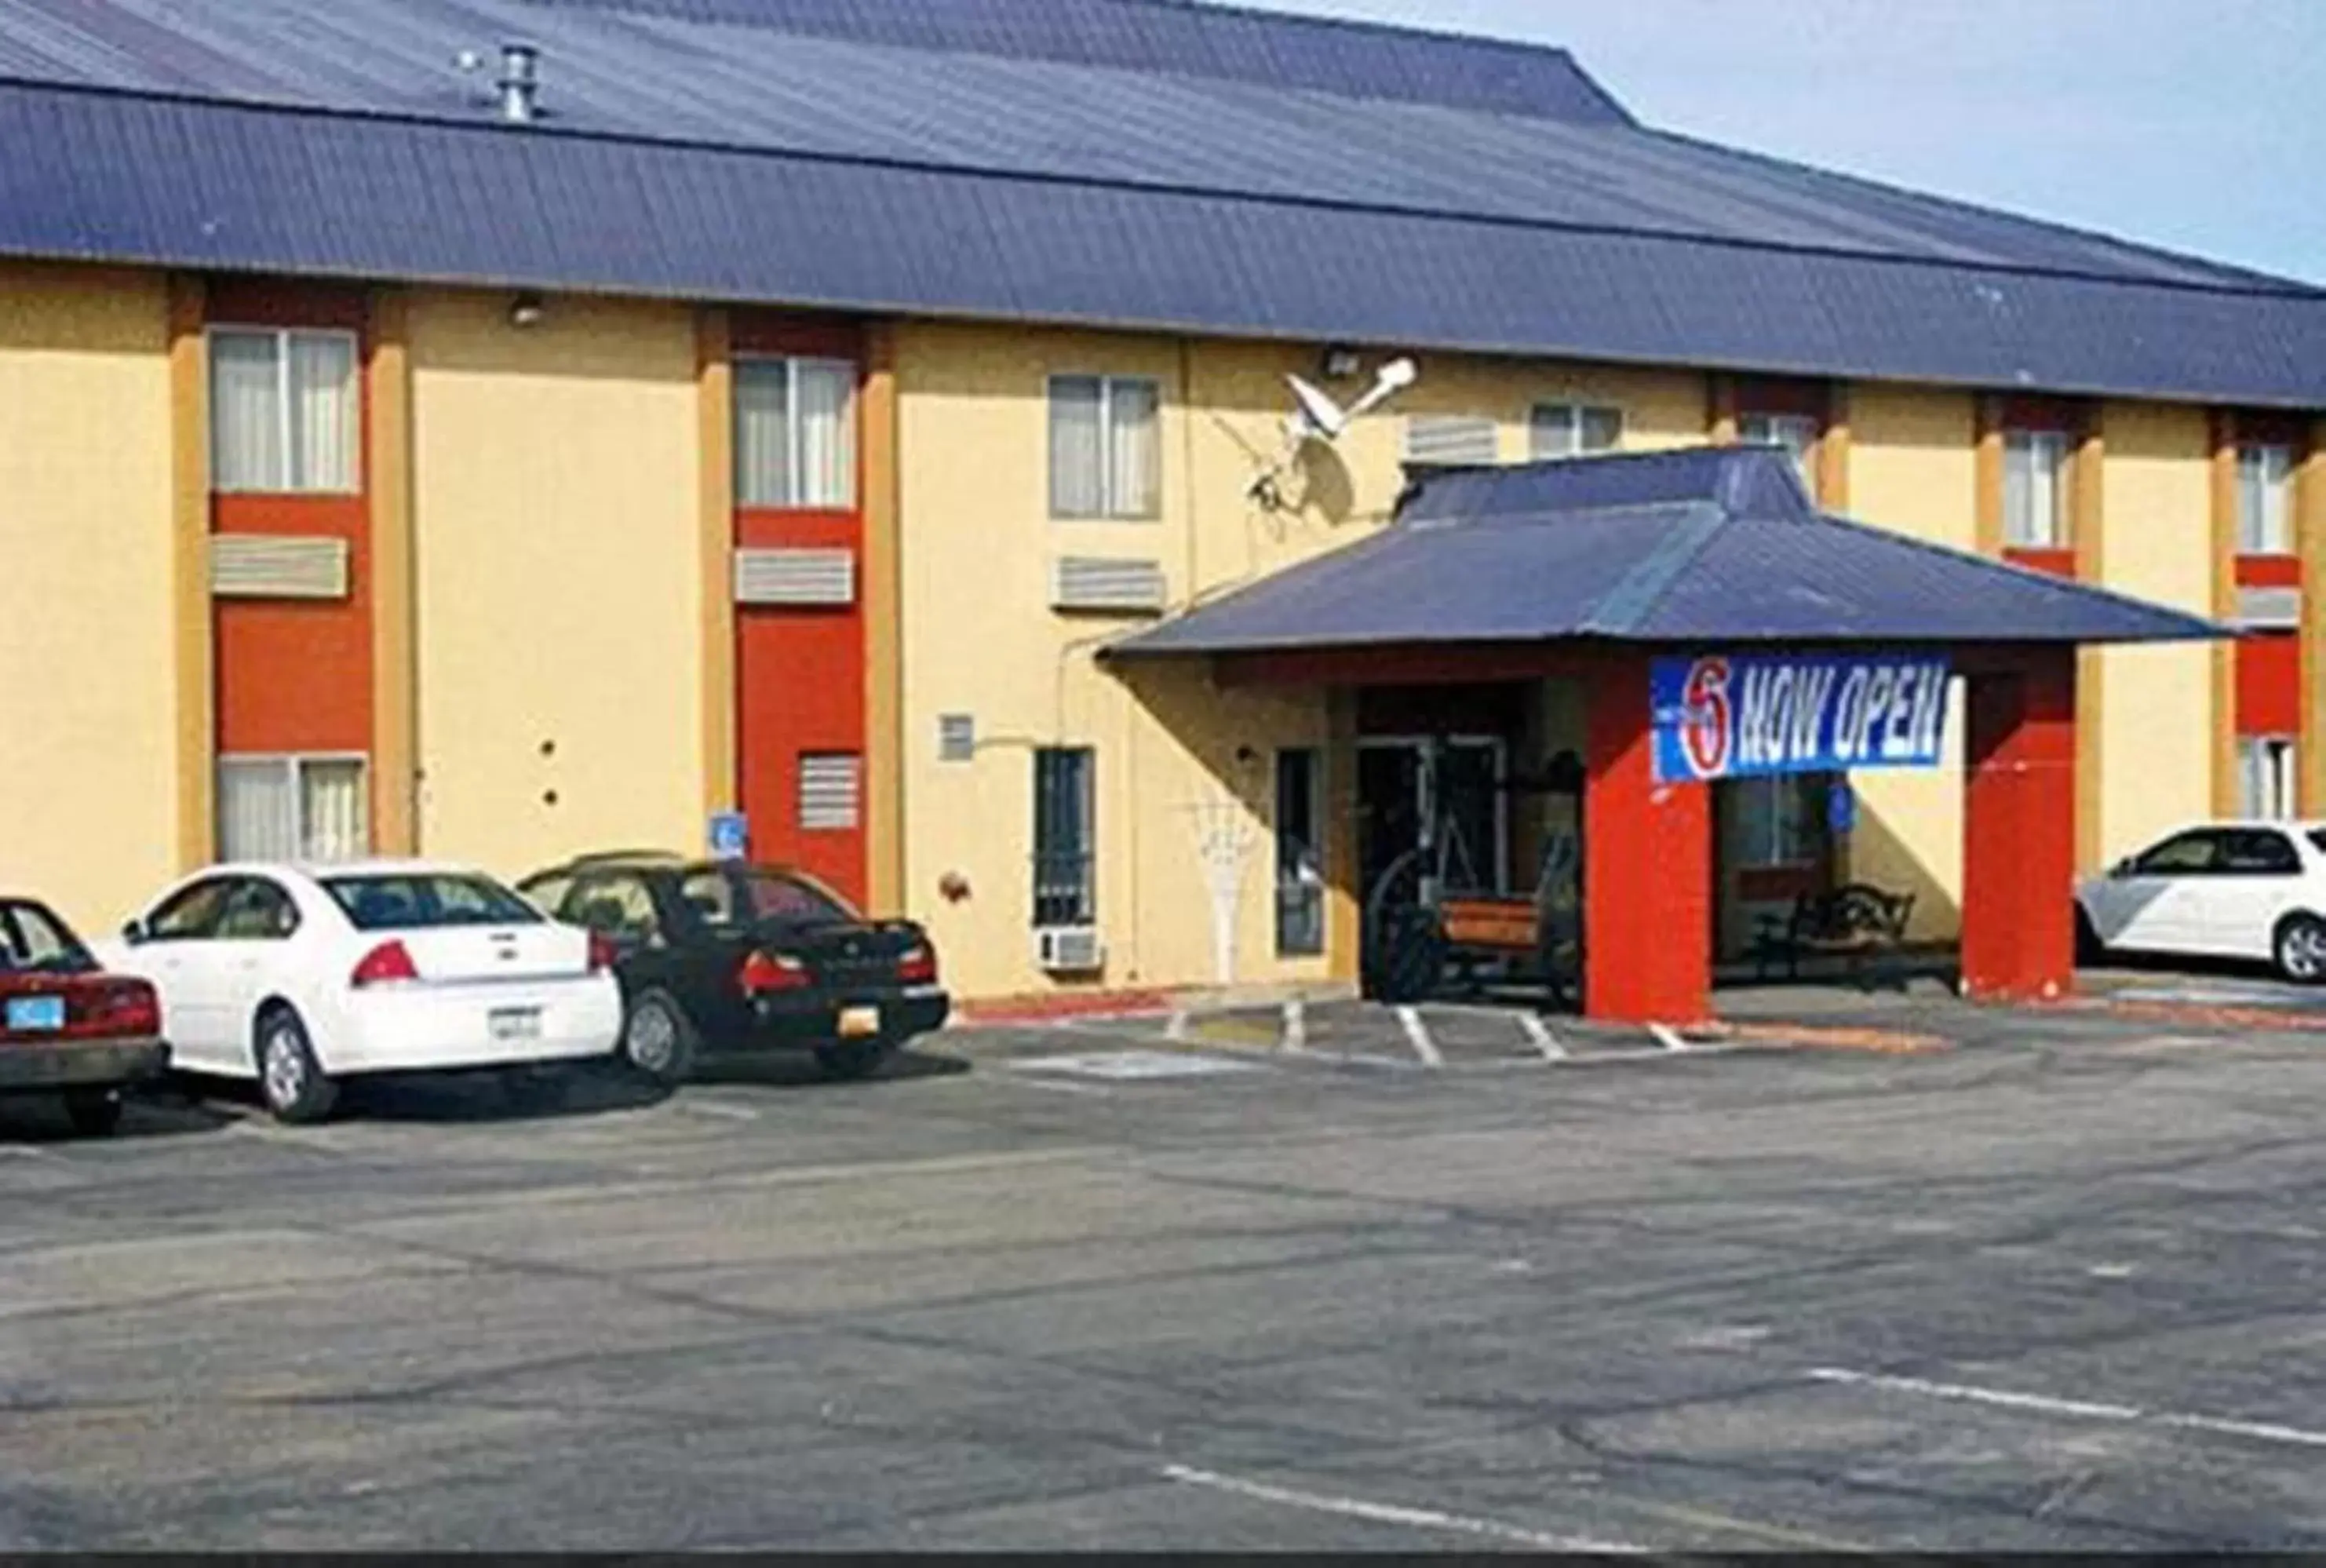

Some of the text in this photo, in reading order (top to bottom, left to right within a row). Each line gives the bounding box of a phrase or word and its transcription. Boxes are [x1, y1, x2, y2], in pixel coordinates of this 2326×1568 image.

[1682, 658, 1946, 776] 6 NOW OPEN
